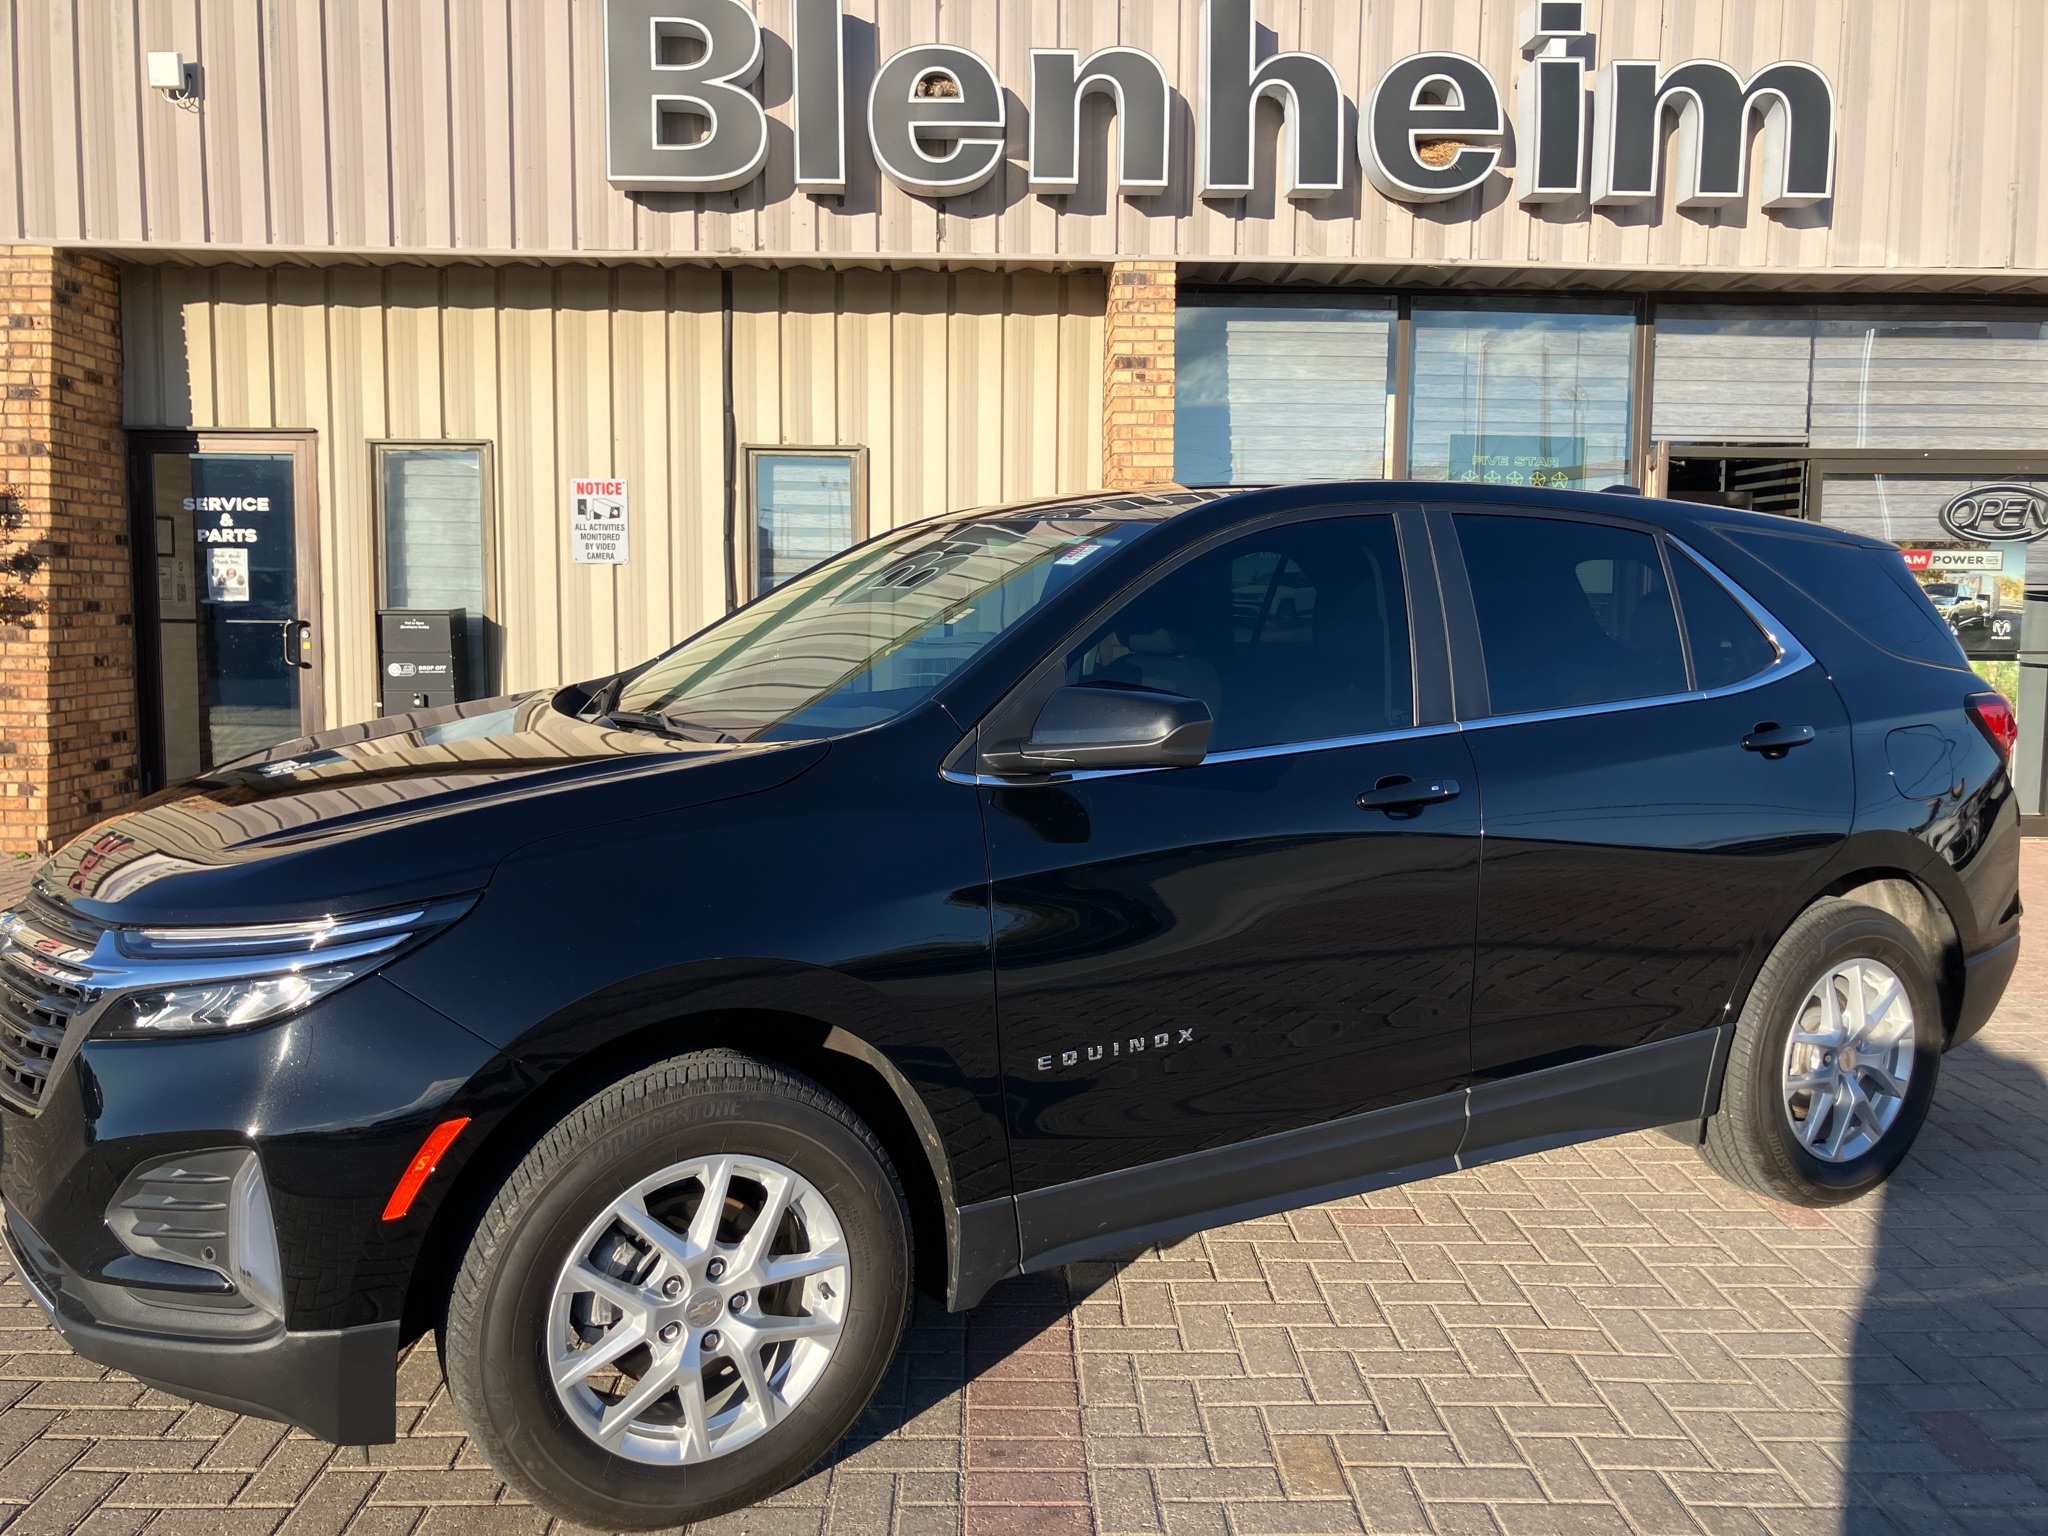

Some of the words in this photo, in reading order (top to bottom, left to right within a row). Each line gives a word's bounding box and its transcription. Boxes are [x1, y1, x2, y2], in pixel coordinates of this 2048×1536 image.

[602, 0, 1837, 209] Blenheim
[1472, 455, 1509, 466] FIVE
[1514, 456, 1559, 467] STAR
[577, 482, 622, 495] NOTICE
[183, 497, 270, 511] SERVICE
[1950, 498, 2048, 527] OPEN
[219, 512, 234, 527] &
[575, 523, 587, 531] ALL
[589, 523, 625, 531] ACTIVITIES
[197, 528, 258, 542] PARTS
[580, 533, 621, 541] MONITORED
[585, 542, 594, 550] BY
[586, 552, 615, 560] CAMERA
[1903, 554, 1927, 565] AM
[1932, 555, 1984, 565] POWER
[1037, 1027, 1193, 1071] EQUINOX
[591, 1099, 743, 1169] BRIDGESTONE
